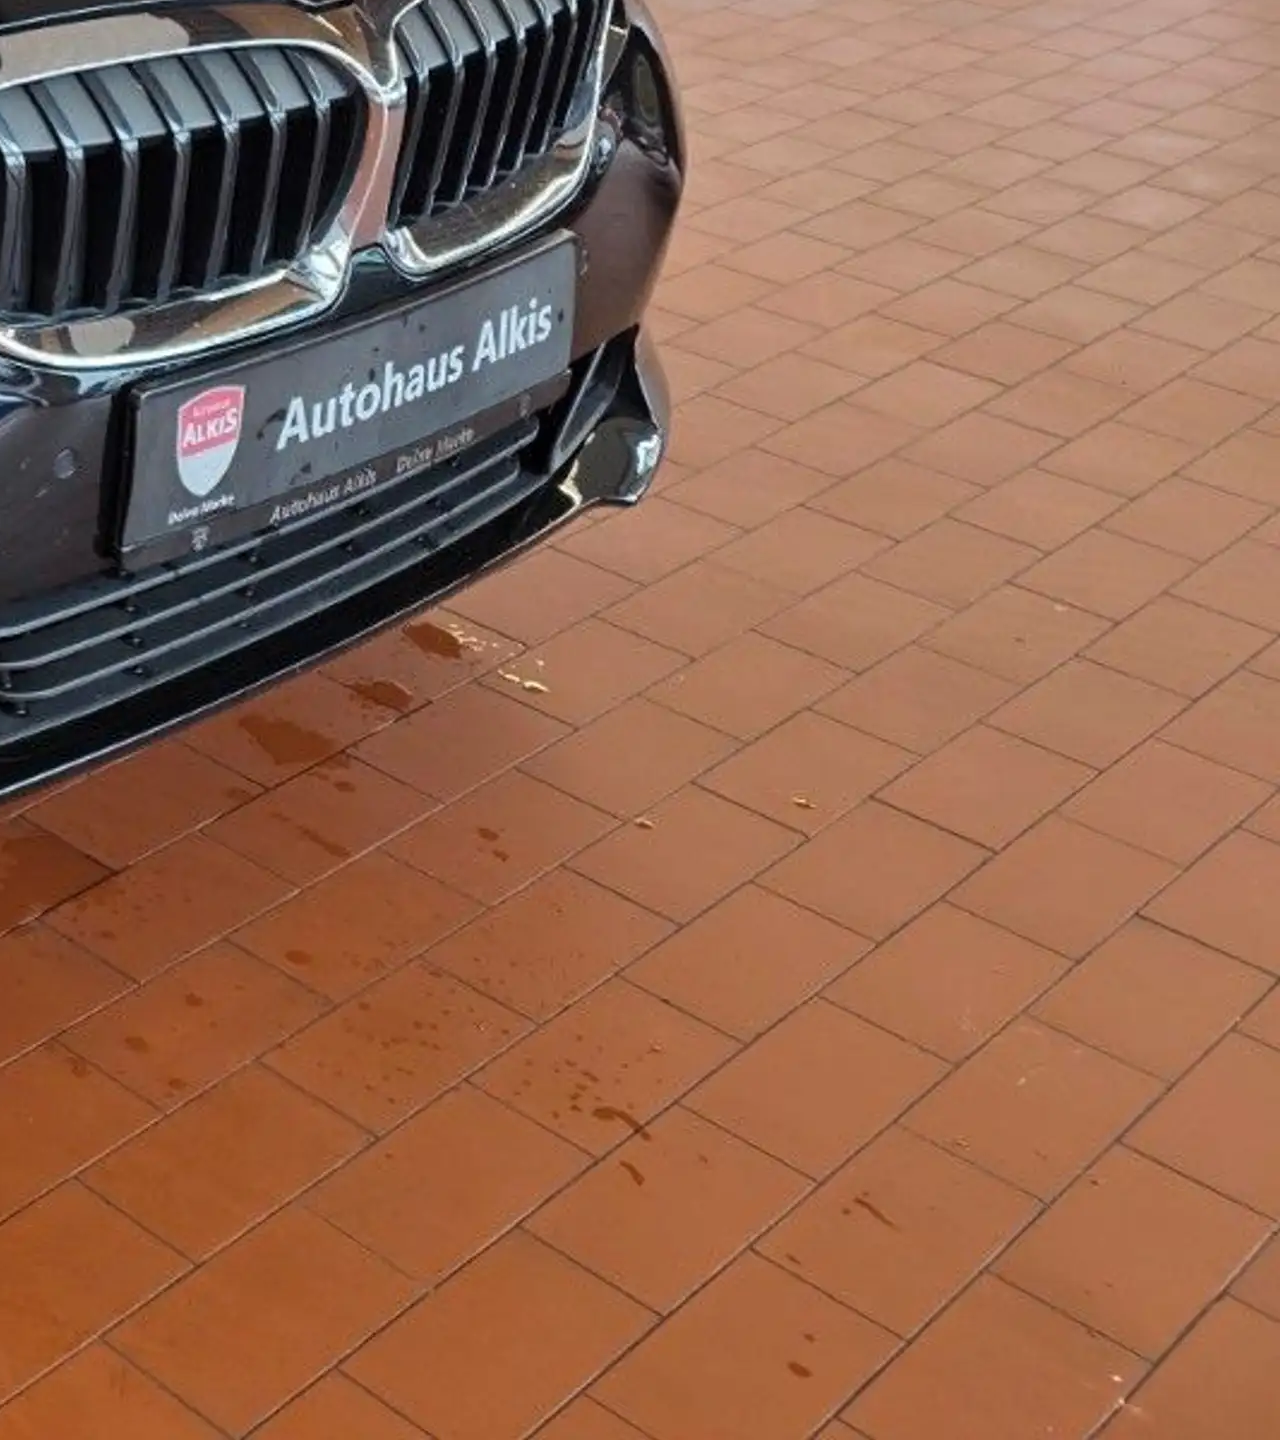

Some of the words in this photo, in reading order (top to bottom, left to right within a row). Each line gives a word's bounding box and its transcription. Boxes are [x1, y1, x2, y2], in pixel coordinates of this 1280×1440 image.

[276, 343, 465, 451] Autohaus
[472, 297, 553, 371] Alkis
[182, 407, 238, 449] ALKIS
